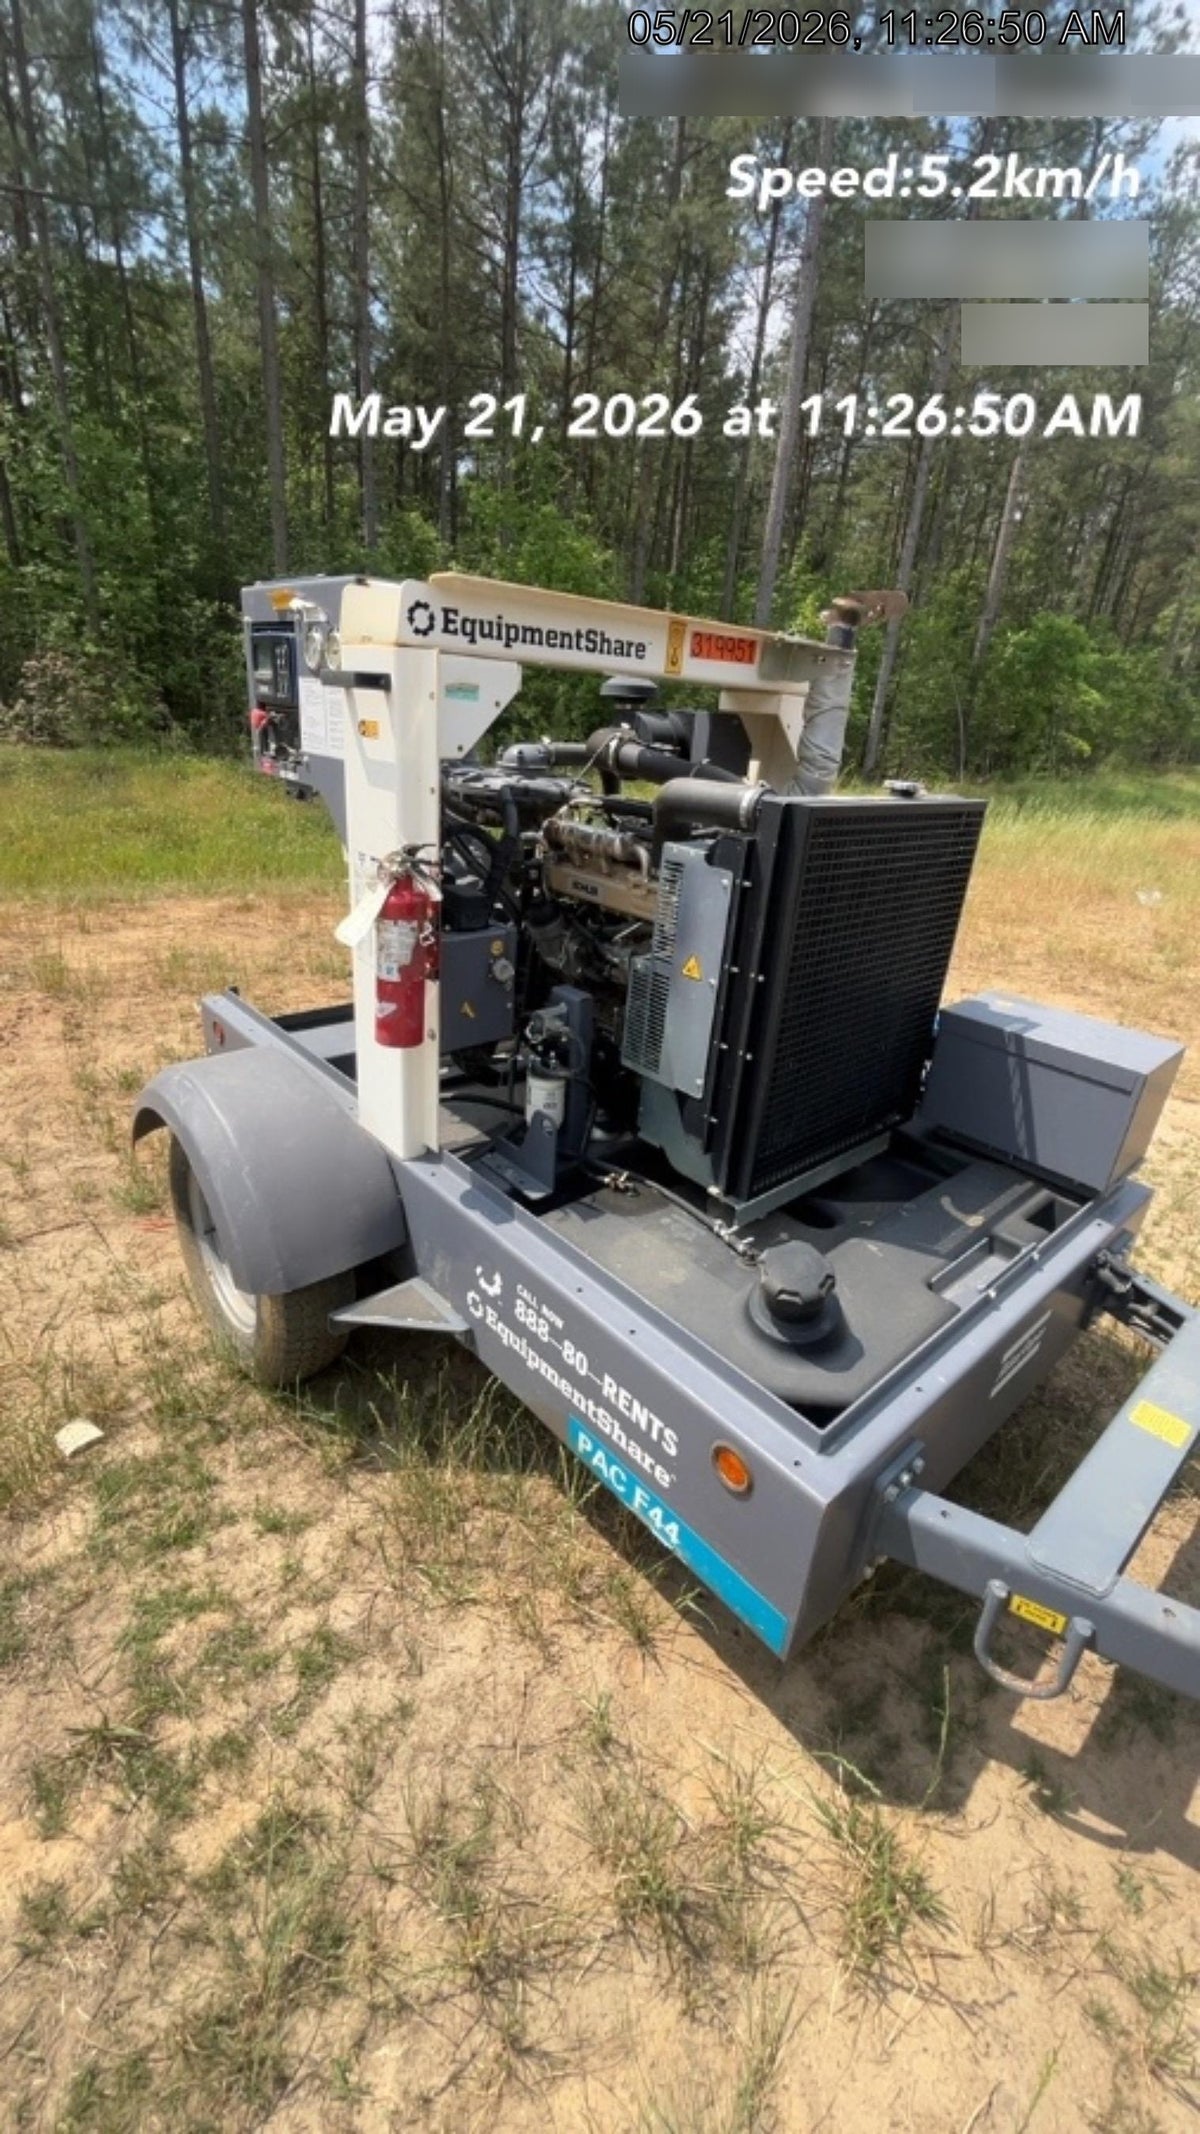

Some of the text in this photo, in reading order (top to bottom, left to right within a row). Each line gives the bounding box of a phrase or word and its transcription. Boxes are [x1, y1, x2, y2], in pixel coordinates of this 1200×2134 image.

[440, 606, 648, 660] EquipmentShare
[690, 632, 756, 664] 319951
[516, 1283, 565, 1331] CALL NOW
[485, 1304, 672, 1489] EquipmentShare
[577, 1430, 681, 1545] PAC F44
